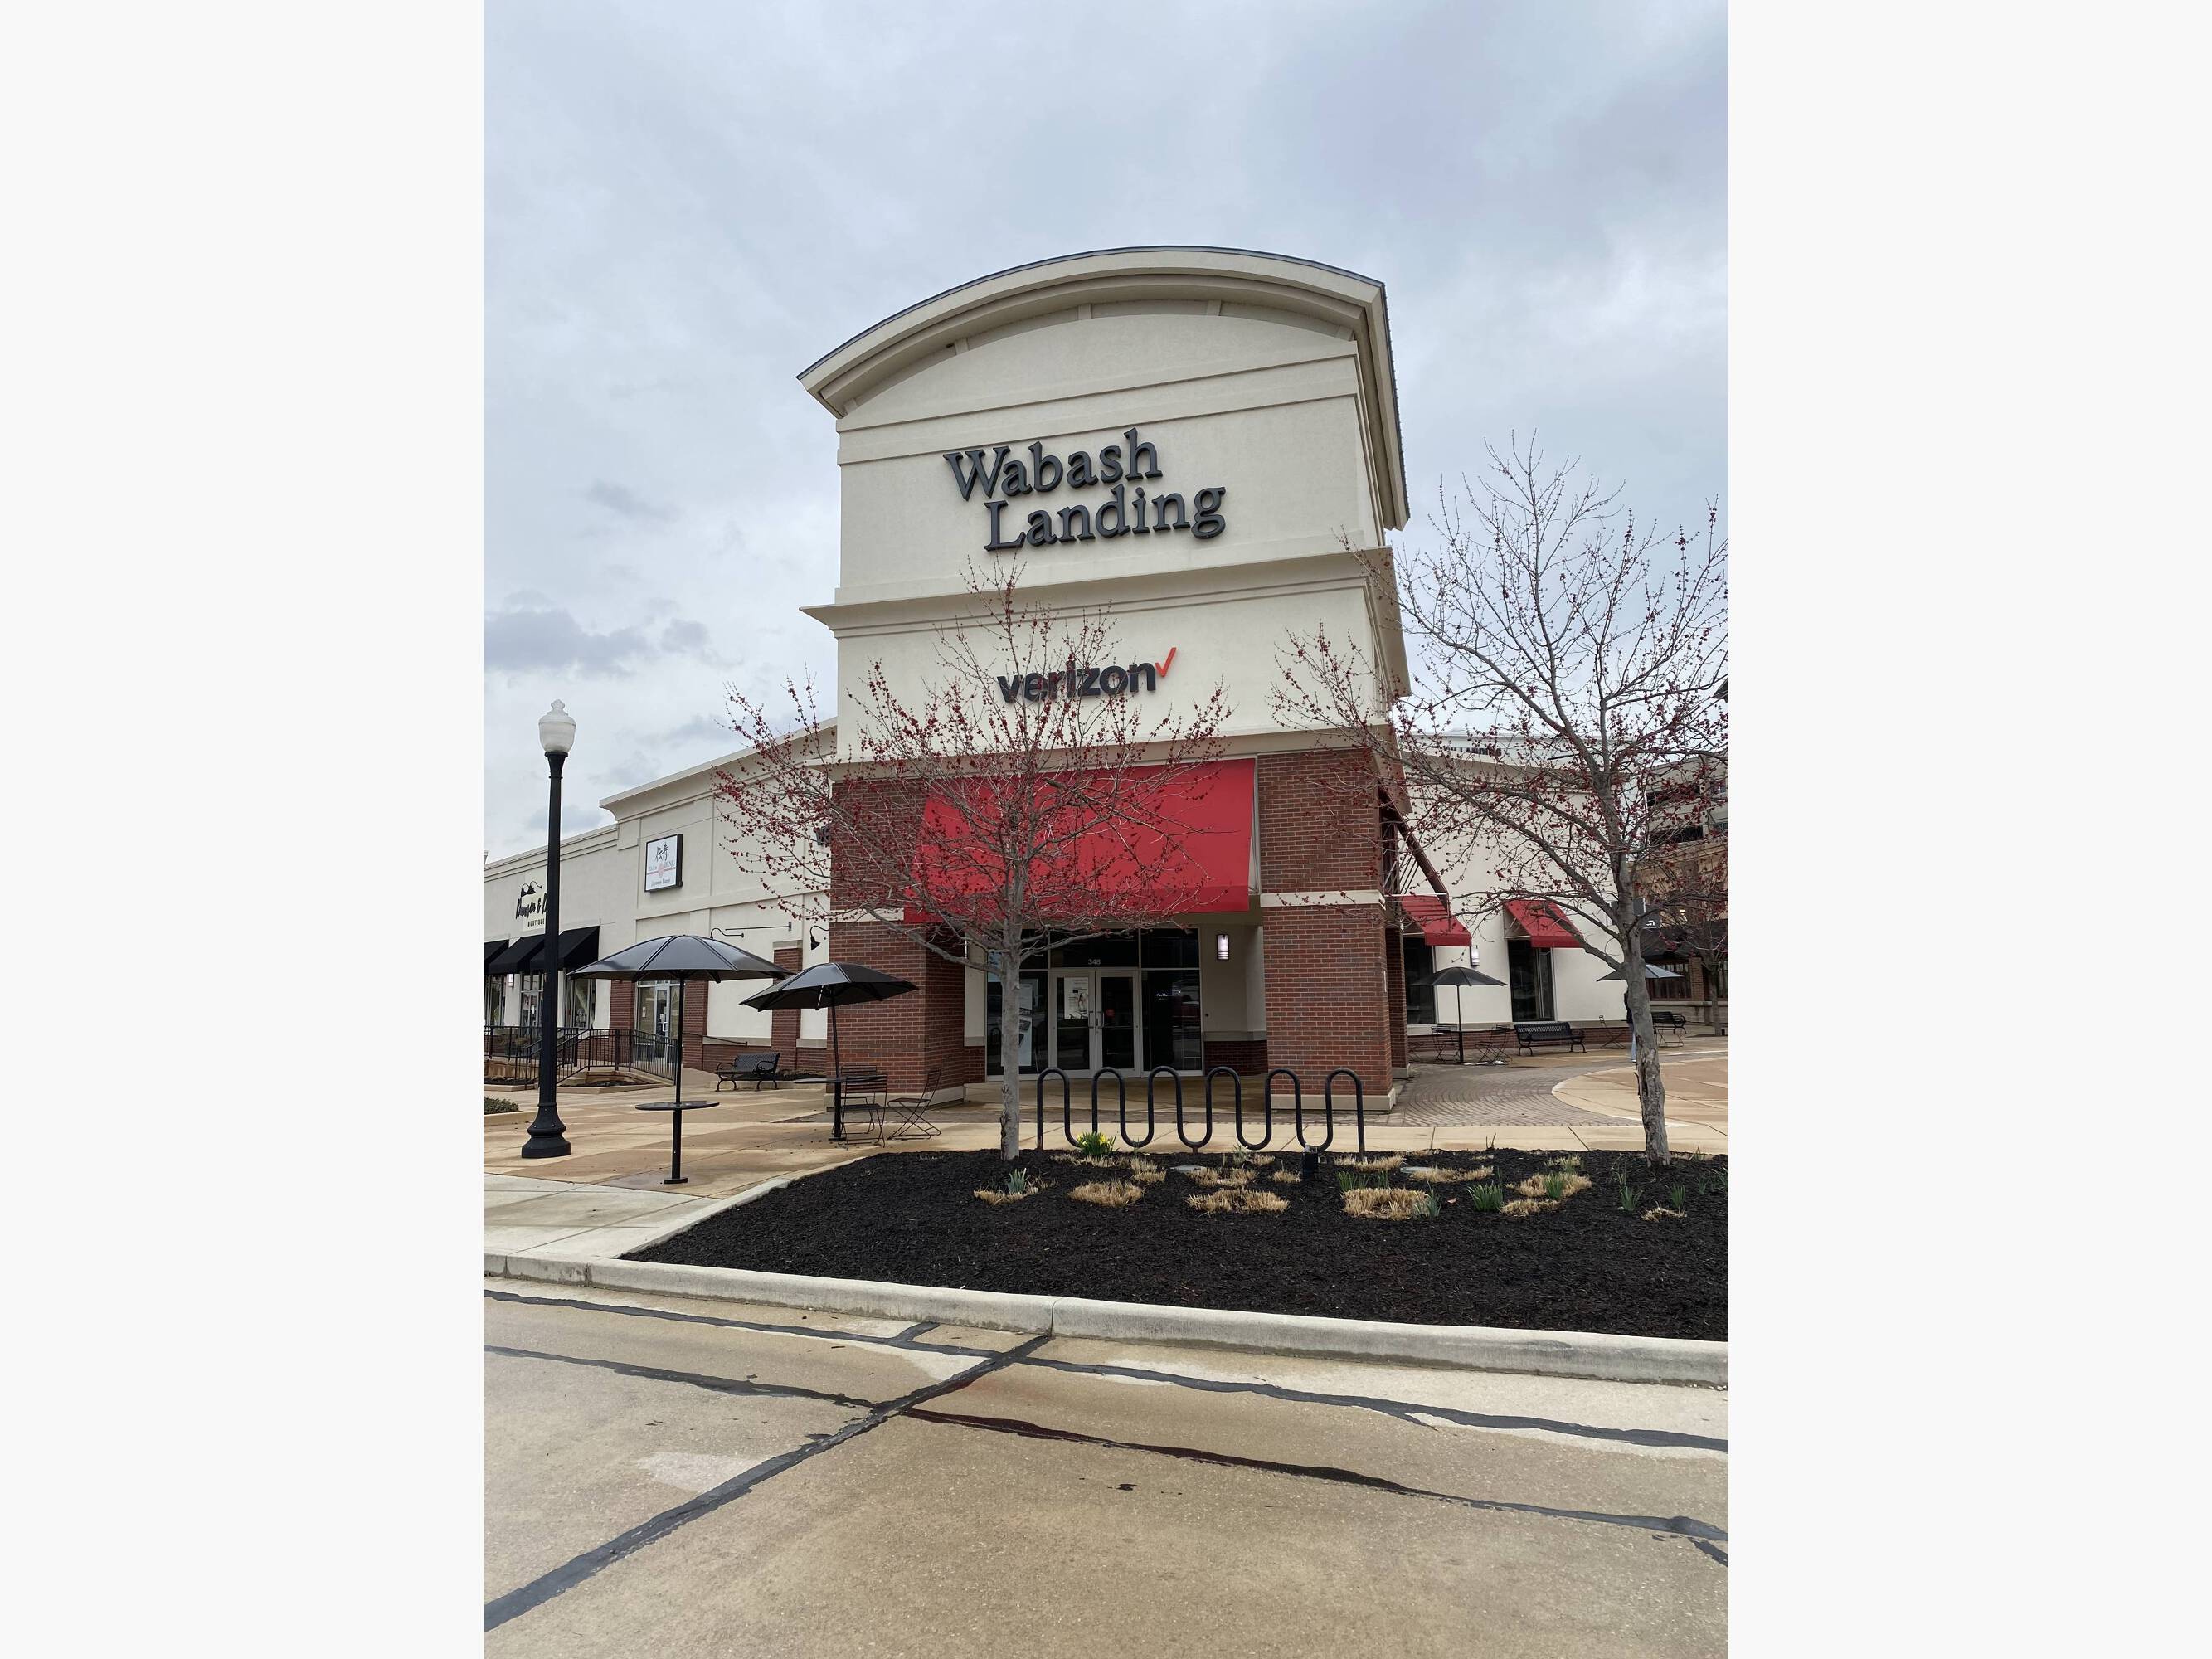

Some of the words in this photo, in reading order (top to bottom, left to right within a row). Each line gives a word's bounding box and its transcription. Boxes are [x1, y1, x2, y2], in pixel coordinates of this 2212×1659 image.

[943, 427, 1163, 501] Wabash
[984, 484, 1226, 552] Landing
[997, 660, 1156, 703] verizon
